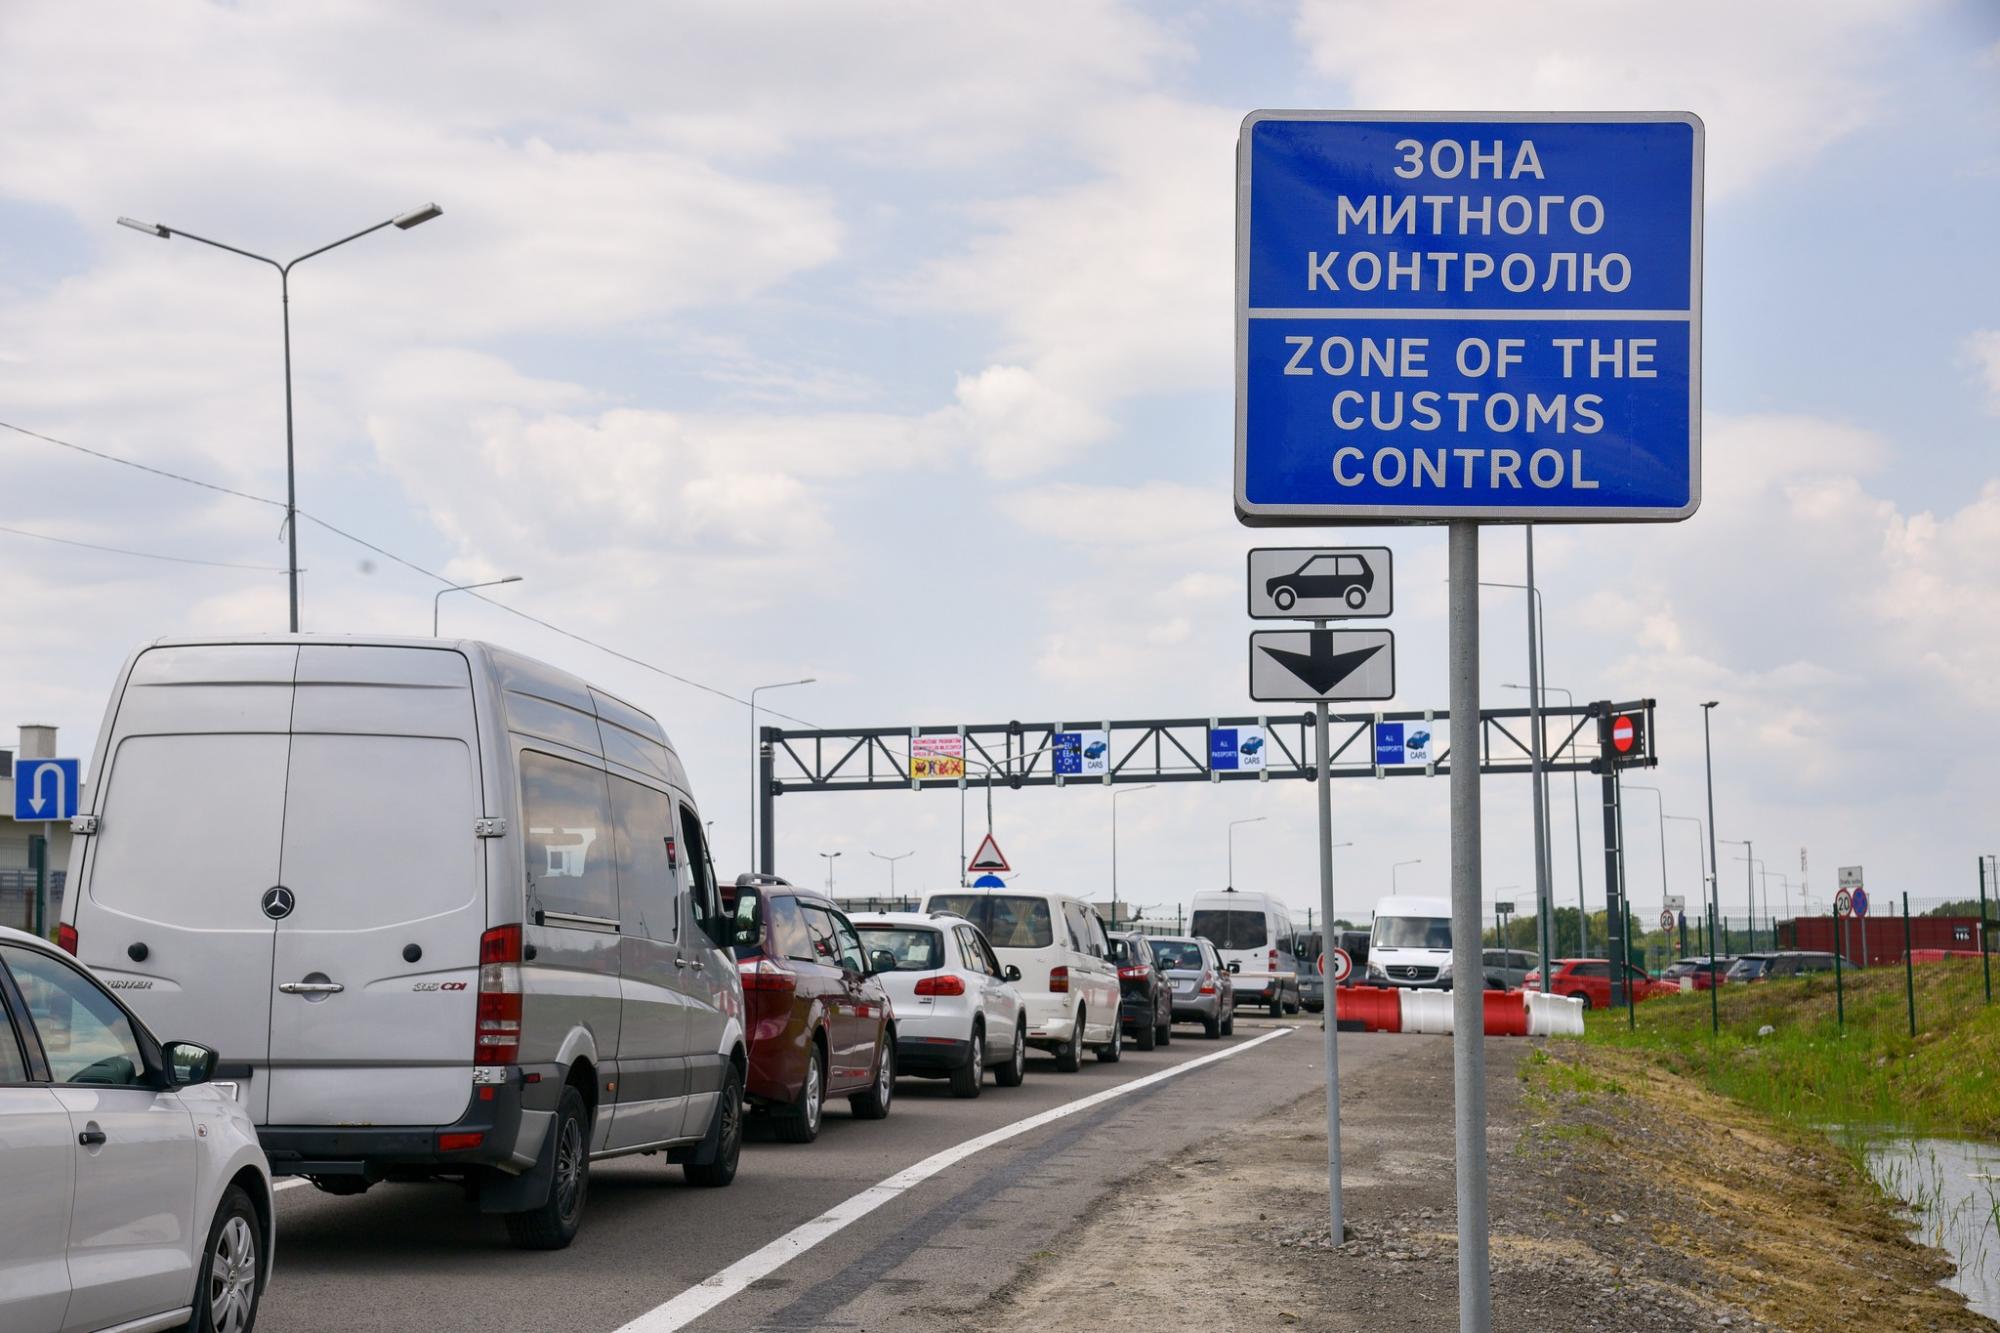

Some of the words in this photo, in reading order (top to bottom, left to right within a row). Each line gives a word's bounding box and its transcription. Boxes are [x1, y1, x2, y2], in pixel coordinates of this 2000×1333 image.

[1394, 139, 1545, 180] ЗОНА
[1337, 195, 1606, 235] МИТНОГО
[1307, 251, 1632, 293] КОНТРОЛЮ
[1284, 336, 1429, 377] ZONE
[1456, 337, 1525, 378] OF
[1552, 338, 1657, 378] THE
[1332, 390, 1604, 434] CUSTOMS
[1332, 447, 1600, 489] CONTROL
[1062, 749, 1075, 758] EEA
[1243, 757, 1260, 765] CARS
[1410, 751, 1427, 760] CARS
[1087, 760, 1103, 769] CARS
[1838, 896, 1850, 911] 20
[1662, 915, 1672, 927] 20
[440, 982, 468, 991] CDI
